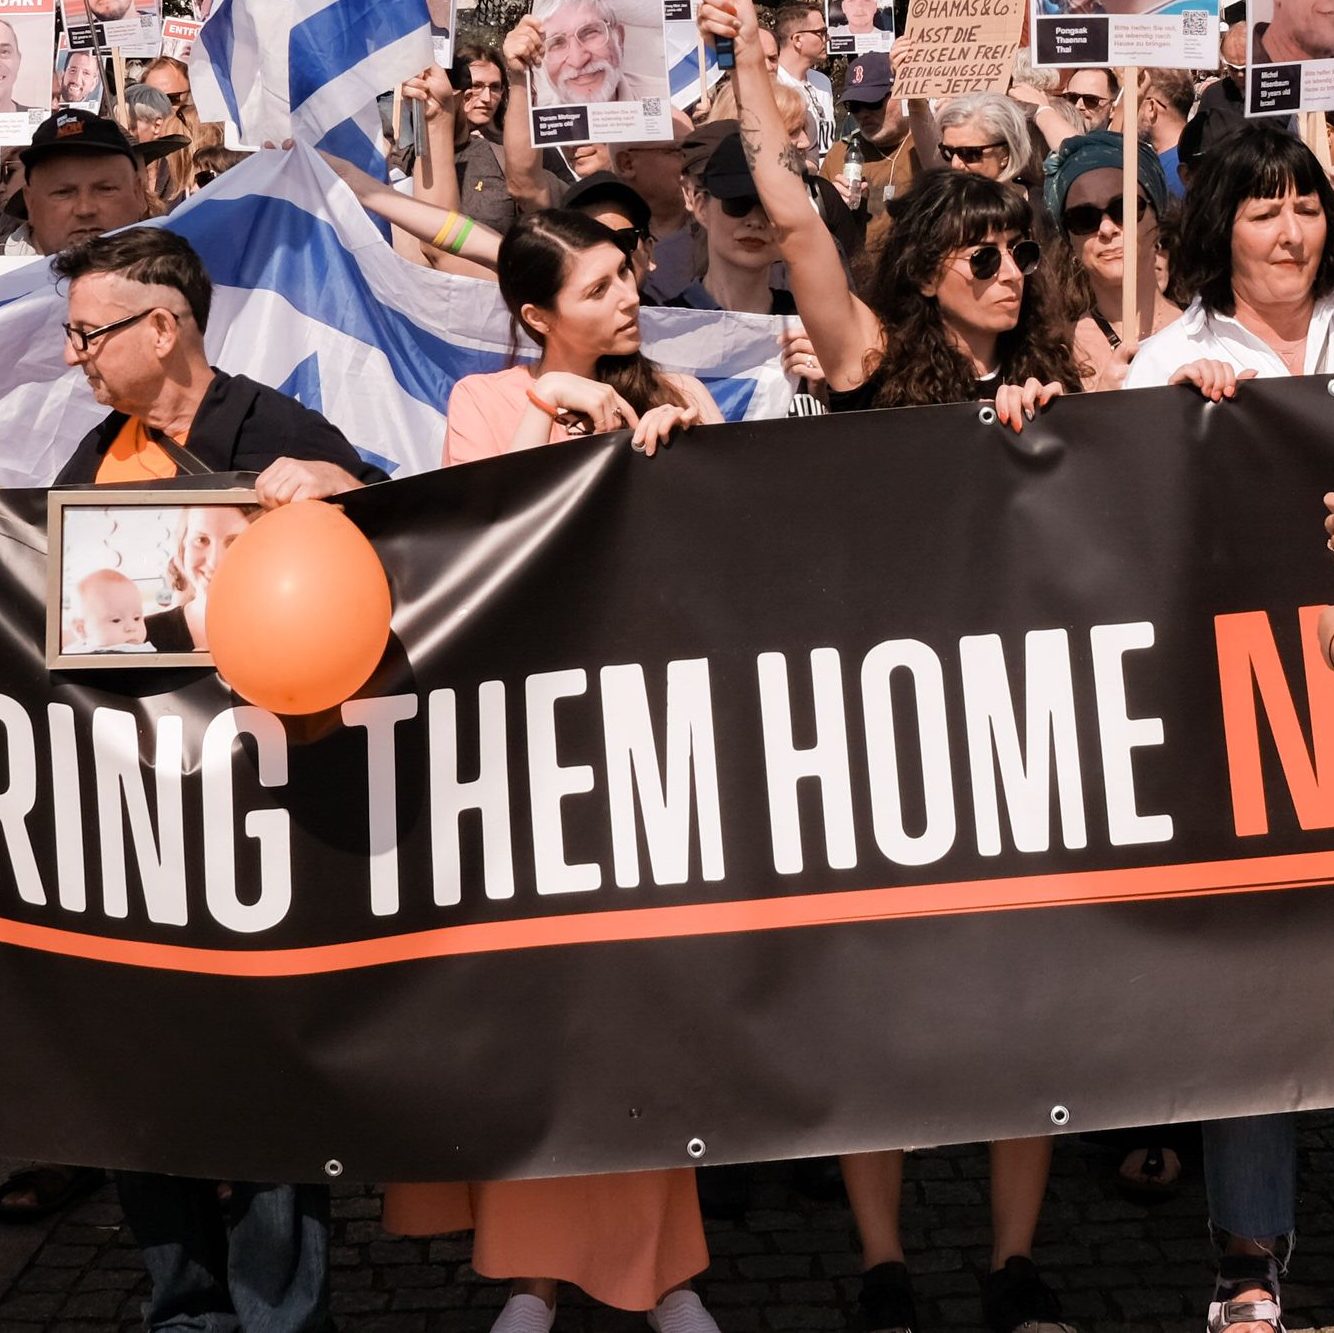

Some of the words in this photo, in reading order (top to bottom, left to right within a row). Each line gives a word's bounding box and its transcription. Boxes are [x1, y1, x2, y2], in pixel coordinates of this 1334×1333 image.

[953, 25, 981, 44] DIE
[1055, 26, 1088, 36] Pongsak
[1056, 36, 1087, 44] Thaenna
[974, 43, 1017, 60] FREI!
[899, 63, 1004, 80] BEDINGUNGSLOS
[894, 79, 932, 97] ALLE
[342, 658, 726, 916] THEM
[759, 621, 1174, 877] HOME
